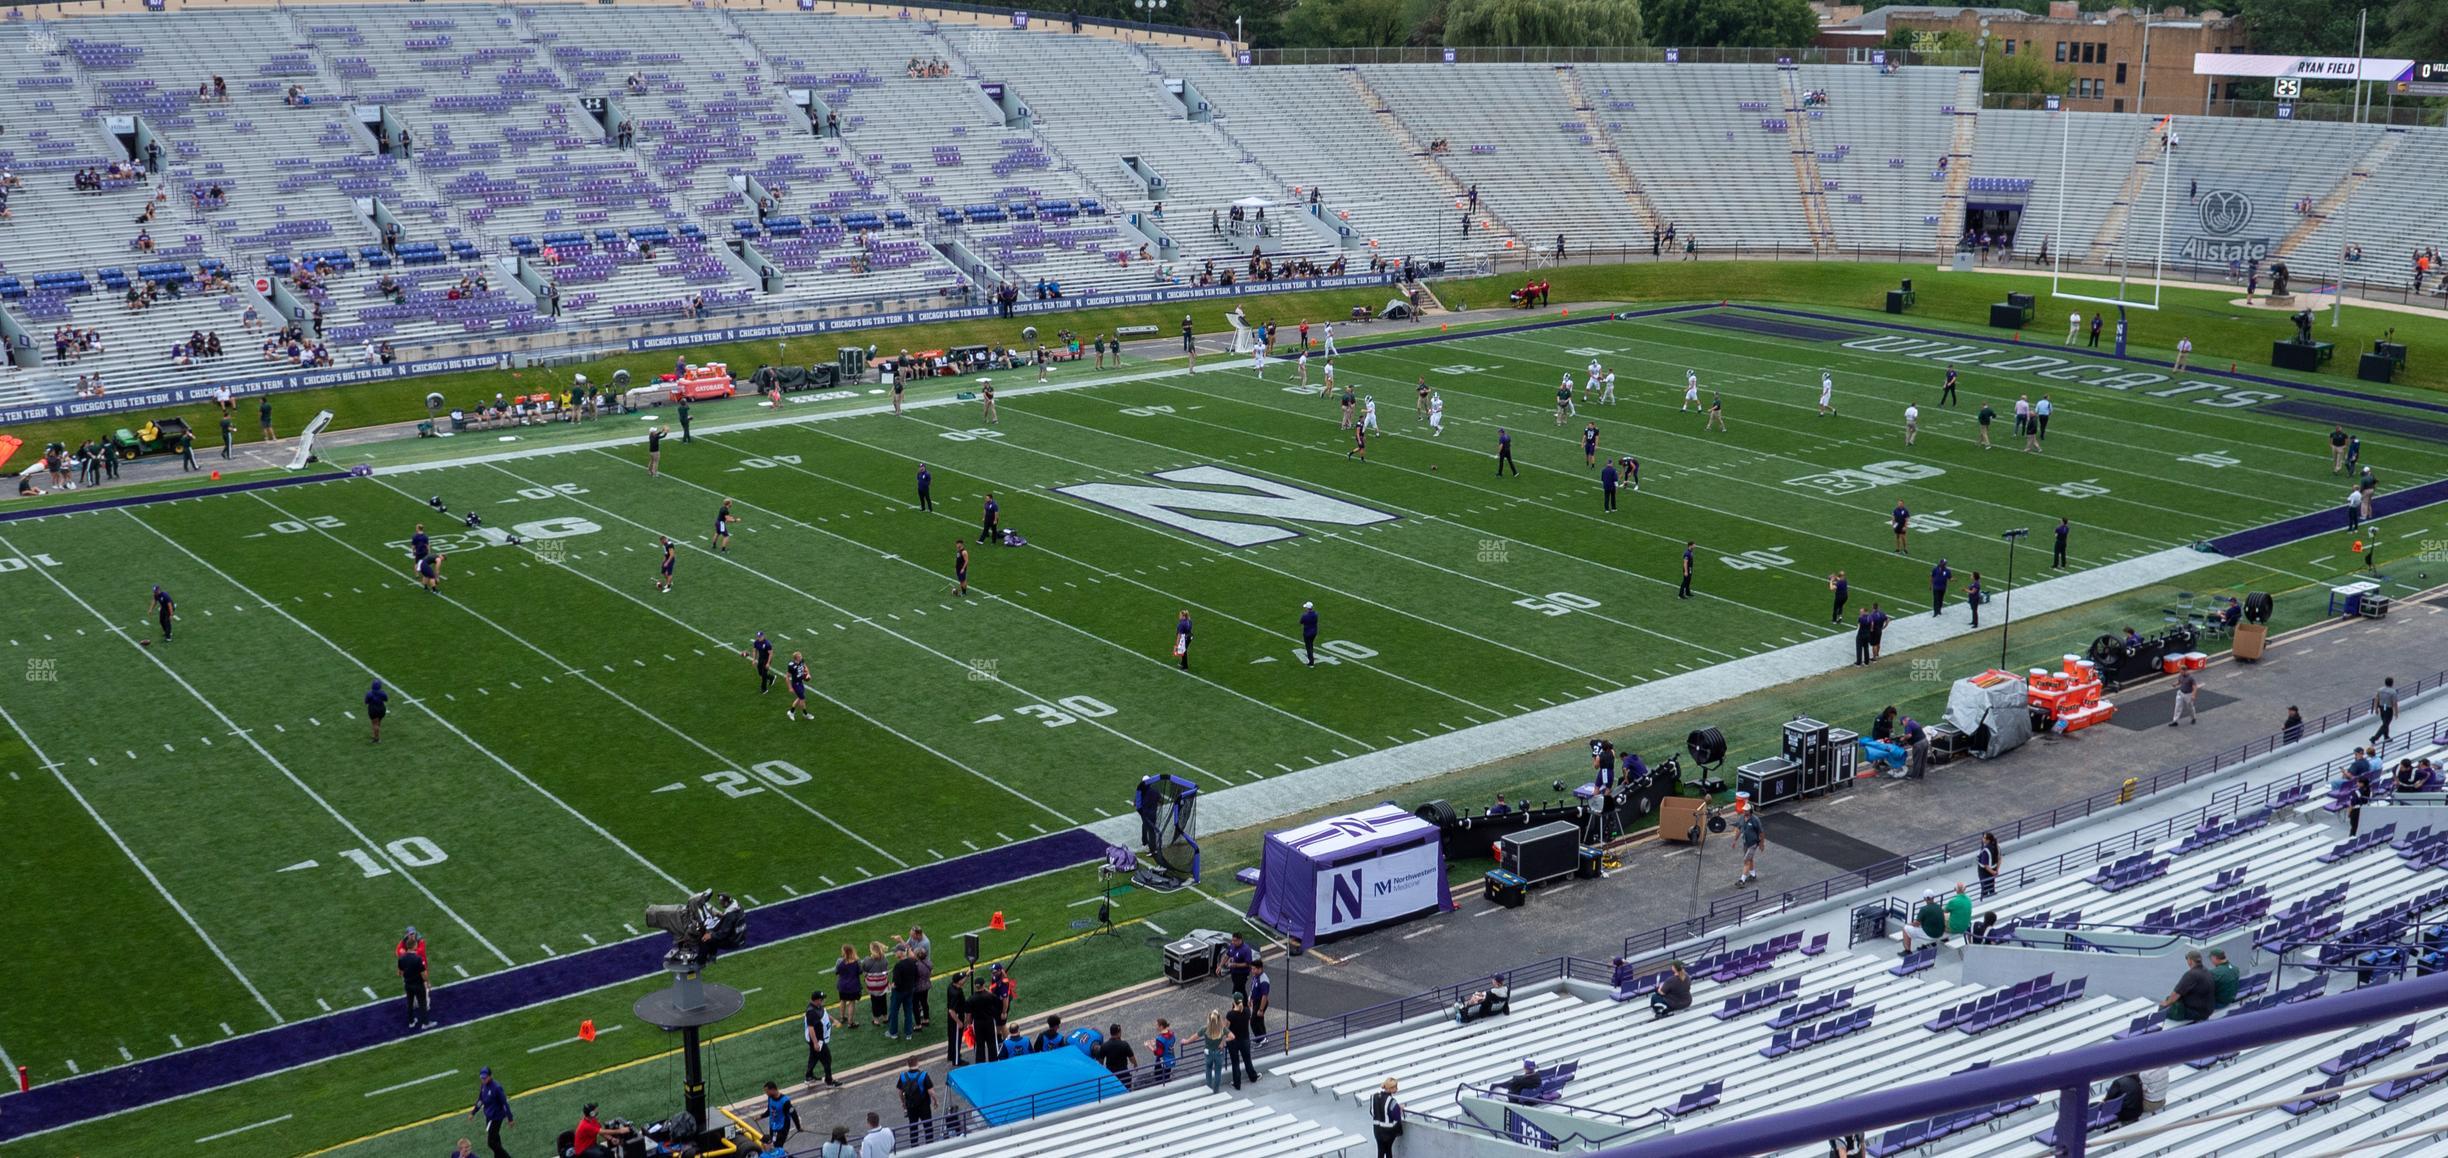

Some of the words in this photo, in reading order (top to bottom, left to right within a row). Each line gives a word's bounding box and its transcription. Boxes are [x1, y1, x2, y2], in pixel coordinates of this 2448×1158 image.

[2297, 61, 2325, 73] RYAN
[2326, 63, 2355, 74] FIELD
[2422, 64, 2431, 78] 0
[2278, 79, 2297, 96] 25
[2181, 238, 2267, 261] Allstate
[631, 339, 638, 348] N
[644, 336, 677, 347] CHICAGO'S
[678, 335, 689, 343] BIG
[691, 334, 702, 342] TEN
[704, 332, 721, 341] TEAM
[727, 330, 734, 339] N
[739, 327, 771, 337] CHICAGO'S
[783, 325, 794, 333] TEN
[796, 323, 814, 331] TEAM
[819, 321, 825, 330] N
[830, 318, 862, 328] CHICAGO'S
[862, 317, 872, 325] BIG
[873, 316, 884, 324] TEN
[885, 314, 902, 323] TEAM
[907, 313, 914, 321] N
[919, 310, 948, 320] CHICAGO'S
[948, 309, 959, 317] BIG
[960, 308, 971, 316] TEN
[972, 307, 988, 315] TEAM
[993, 306, 999, 314] N
[1033, 302, 1043, 310] BIG
[1055, 300, 1070, 308] TEAM
[1076, 298, 1082, 306] N
[1086, 296, 1114, 305] CHICAGO'S
[1115, 294, 1124, 303] BIG
[1167, 290, 1194, 298] CHICAGO'S
[1234, 285, 1240, 293] N
[1244, 283, 1271, 292] CHICAGO'S
[1310, 279, 1316, 287] N
[1321, 278, 1347, 286] CHICAGO'S
[1841, 335, 2284, 409] WILDCATS
[5, 410, 22, 421] TEN
[24, 407, 47, 418] TEAM
[54, 405, 64, 416] N
[70, 399, 112, 413] CHICAGO'S
[113, 398, 127, 408] BIG
[129, 396, 145, 406] TEN
[147, 393, 169, 403] TEAM
[175, 390, 183, 400] N
[231, 383, 244, 393] BIG
[245, 382, 260, 391] TEN
[262, 379, 283, 389] TEAM
[289, 377, 297, 387] N
[303, 372, 341, 385] CHICAGO'S
[342, 371, 355, 380] BIG
[356, 369, 370, 378] TEN
[372, 366, 392, 376] TEAM
[398, 364, 405, 374] N
[411, 360, 448, 372] CHICAGO'S
[449, 359, 461, 368] BIG
[462, 358, 476, 367] TEN
[477, 355, 496, 365] TEAM
[1118, 405, 1177, 418] 40
[938, 428, 1006, 442] 50
[739, 454, 802, 469] 40
[2175, 452, 2242, 468] 10
[517, 482, 591, 500] 30
[2038, 481, 2112, 500] 20
[1056, 464, 1400, 547] N
[268, 515, 347, 534] 20
[0, 553, 63, 573] 10
[1719, 550, 1796, 571] 40
[1511, 591, 1602, 617] 50
[1291, 640, 1379, 666] 40
[1013, 695, 1119, 728] 30
[701, 760, 813, 799] 20
[338, 836, 449, 879] 10
[1393, 867, 1437, 885] Northwestern
[1393, 880, 1421, 892] Medicine
[1331, 868, 1363, 925] N
